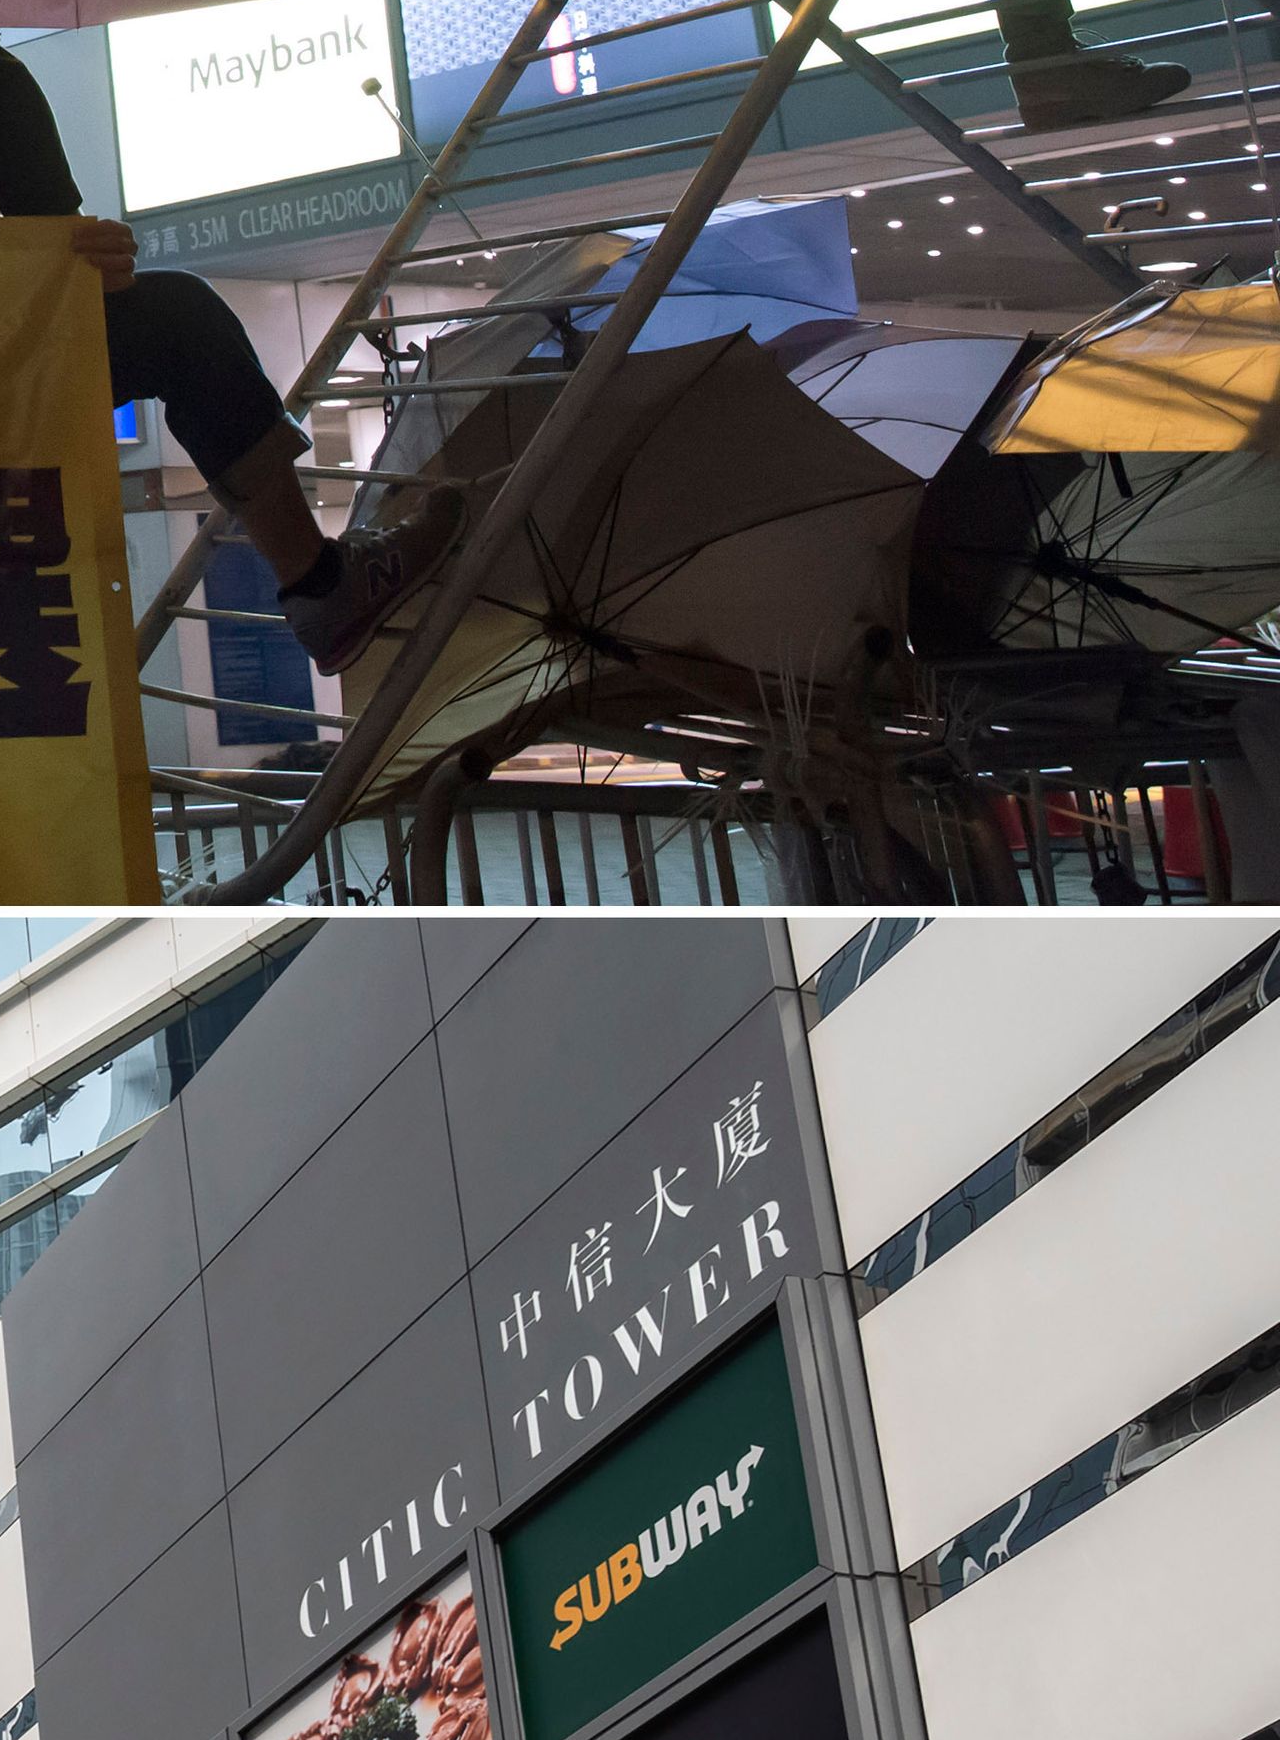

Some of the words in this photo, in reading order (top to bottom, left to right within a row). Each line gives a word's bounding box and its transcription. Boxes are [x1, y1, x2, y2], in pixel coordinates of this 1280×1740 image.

[188, 14, 368, 93] Maybank
[142, 230, 180, 260] 淨高
[189, 216, 229, 252] 3.5M
[238, 193, 294, 239] CLEAR
[297, 179, 408, 231] HEADROOM
[499, 1081, 772, 1360] 中信大廈
[297, 1462, 468, 1639] CITIC
[512, 1200, 790, 1460] TOWER
[549, 1443, 765, 1652] SUBWAY
